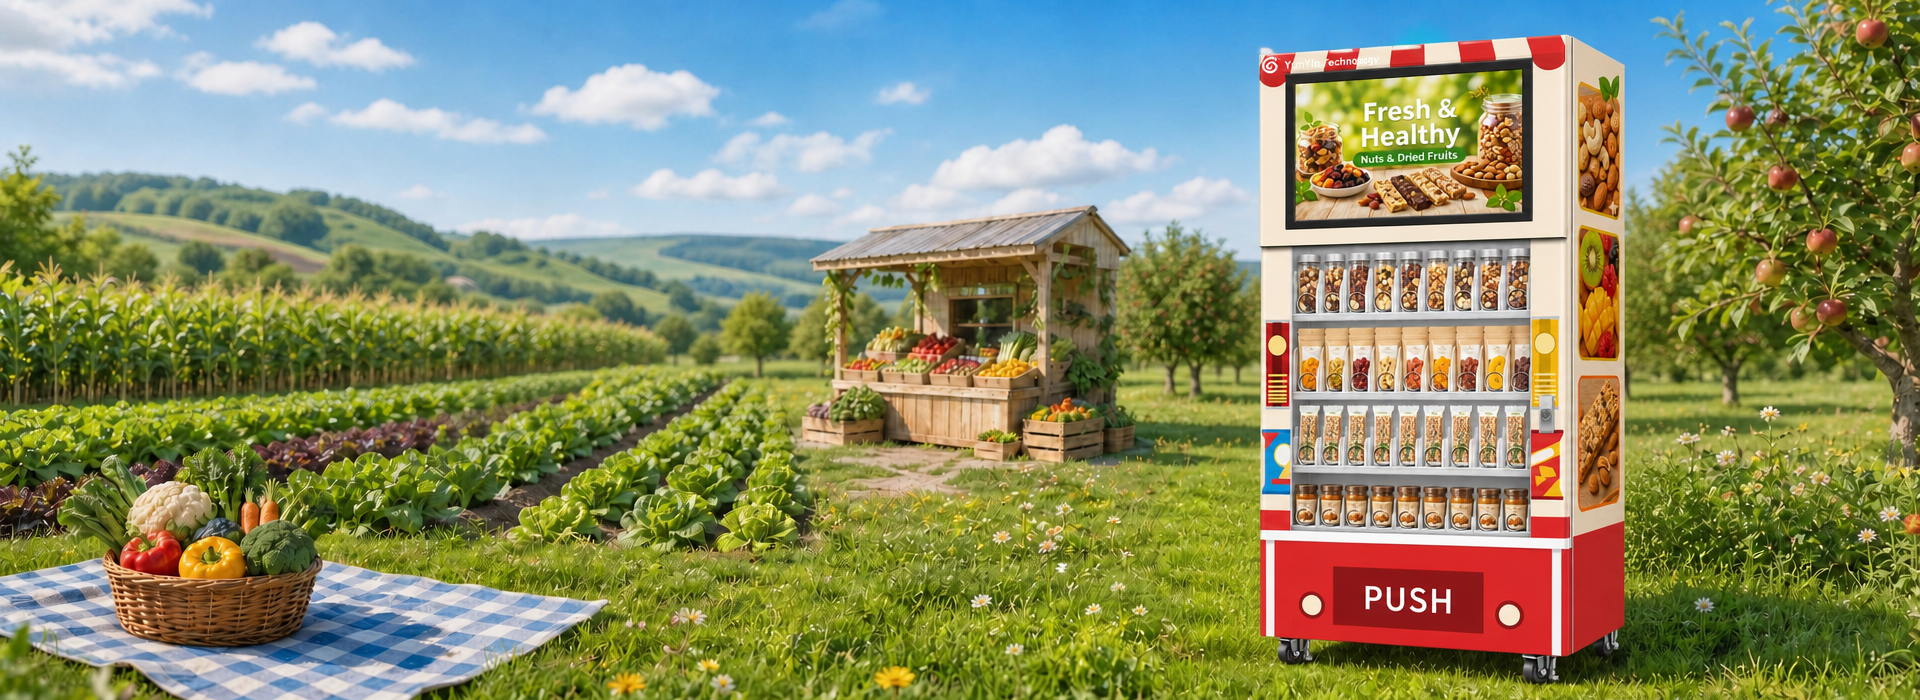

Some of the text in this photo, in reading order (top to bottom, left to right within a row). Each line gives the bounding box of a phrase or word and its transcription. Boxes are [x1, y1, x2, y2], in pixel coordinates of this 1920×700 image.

[1323, 56, 1380, 68] Technology
[1363, 98, 1457, 122] Fresh &
[1361, 122, 1460, 149] Healthy
[1360, 150, 1458, 164] Nuts & Dried Fruits
[1365, 585, 1452, 614] PUSH
